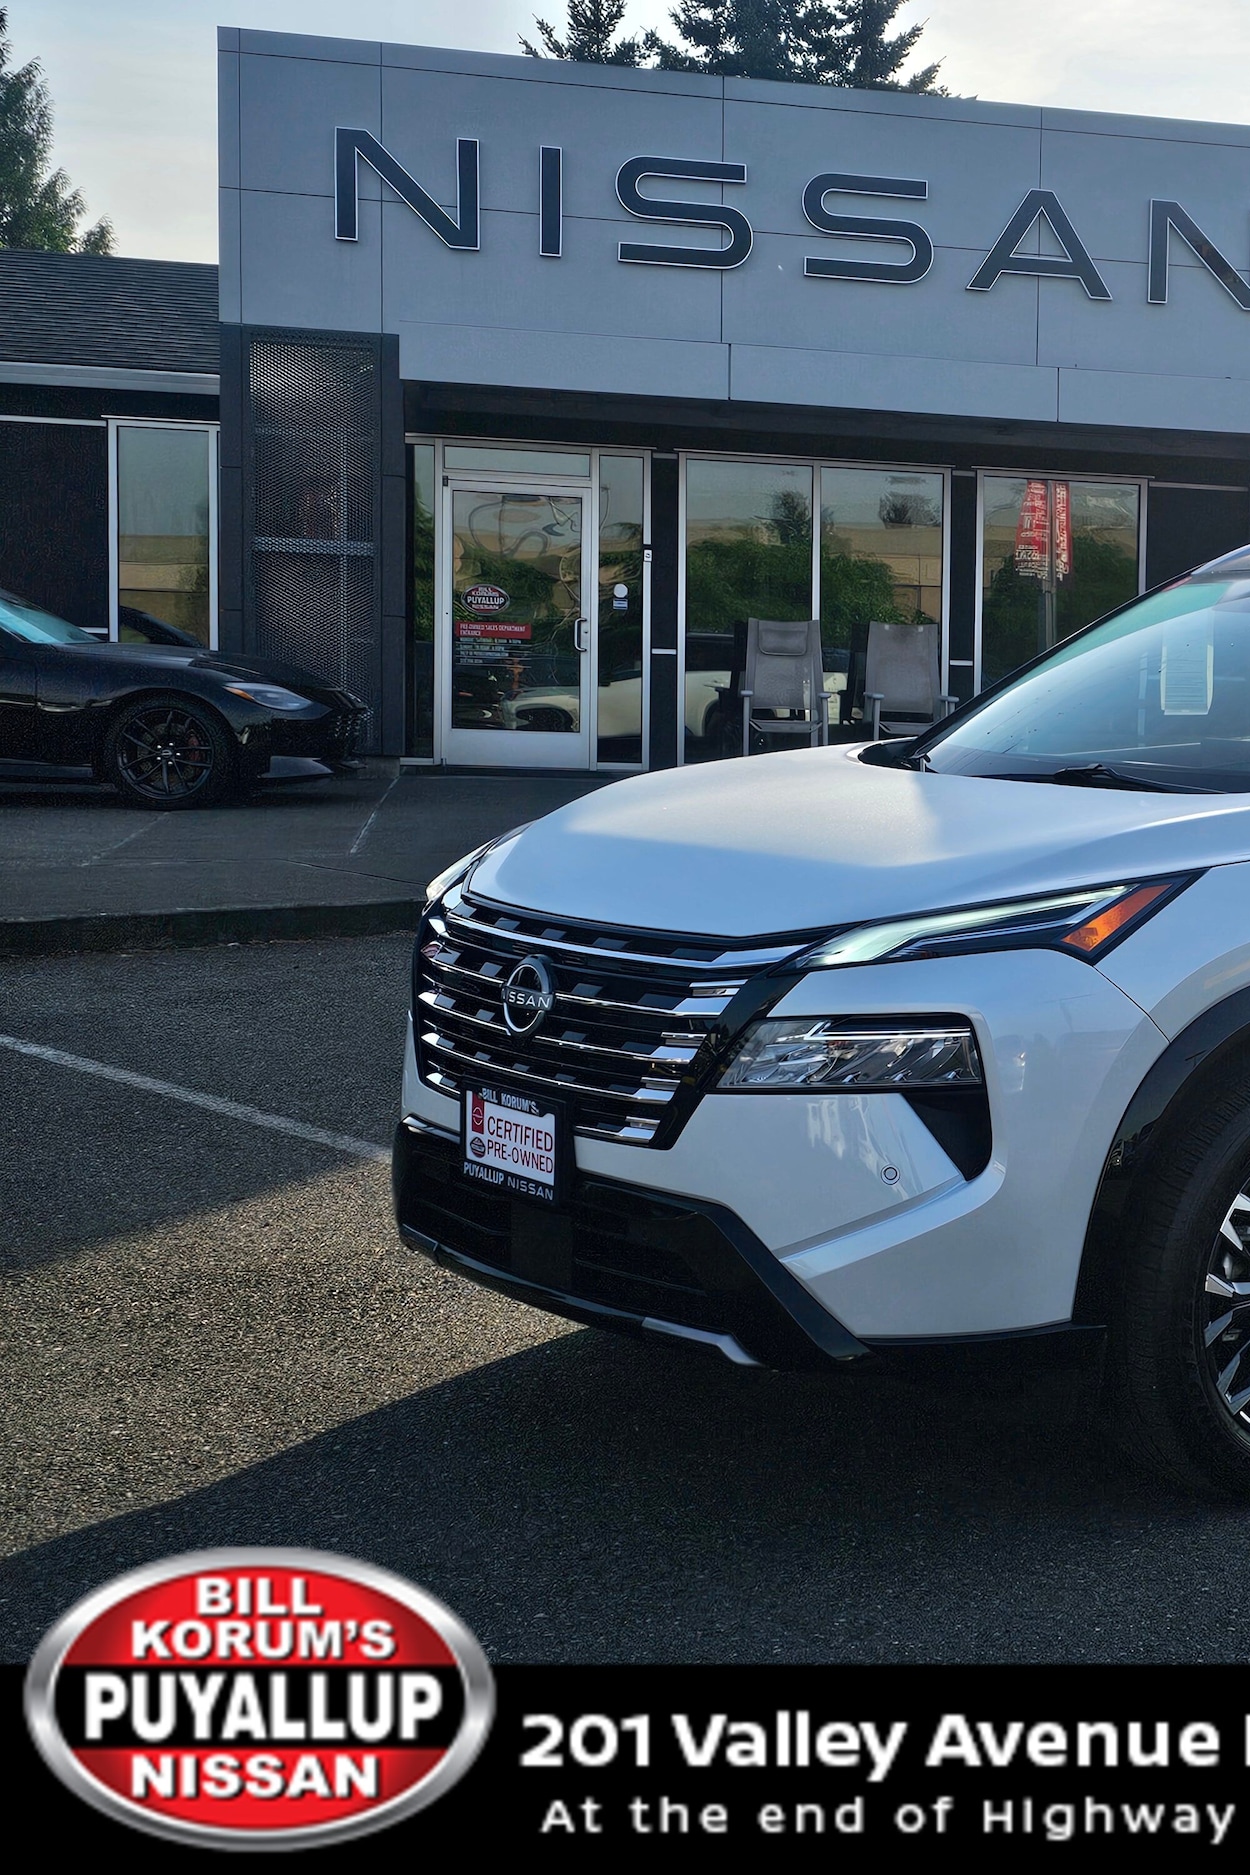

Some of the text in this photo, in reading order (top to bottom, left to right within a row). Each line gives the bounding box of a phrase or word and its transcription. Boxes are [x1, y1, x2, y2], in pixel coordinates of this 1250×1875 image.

[467, 596, 505, 605] PUYALLUP
[502, 987, 550, 1008] SSAN
[481, 1088, 540, 1114] BILL KORUM'S
[487, 1116, 554, 1153] CERTIFIED
[487, 1139, 554, 1174] PRE-OWNED
[463, 1162, 554, 1200] PUYALLUP NISSAN
